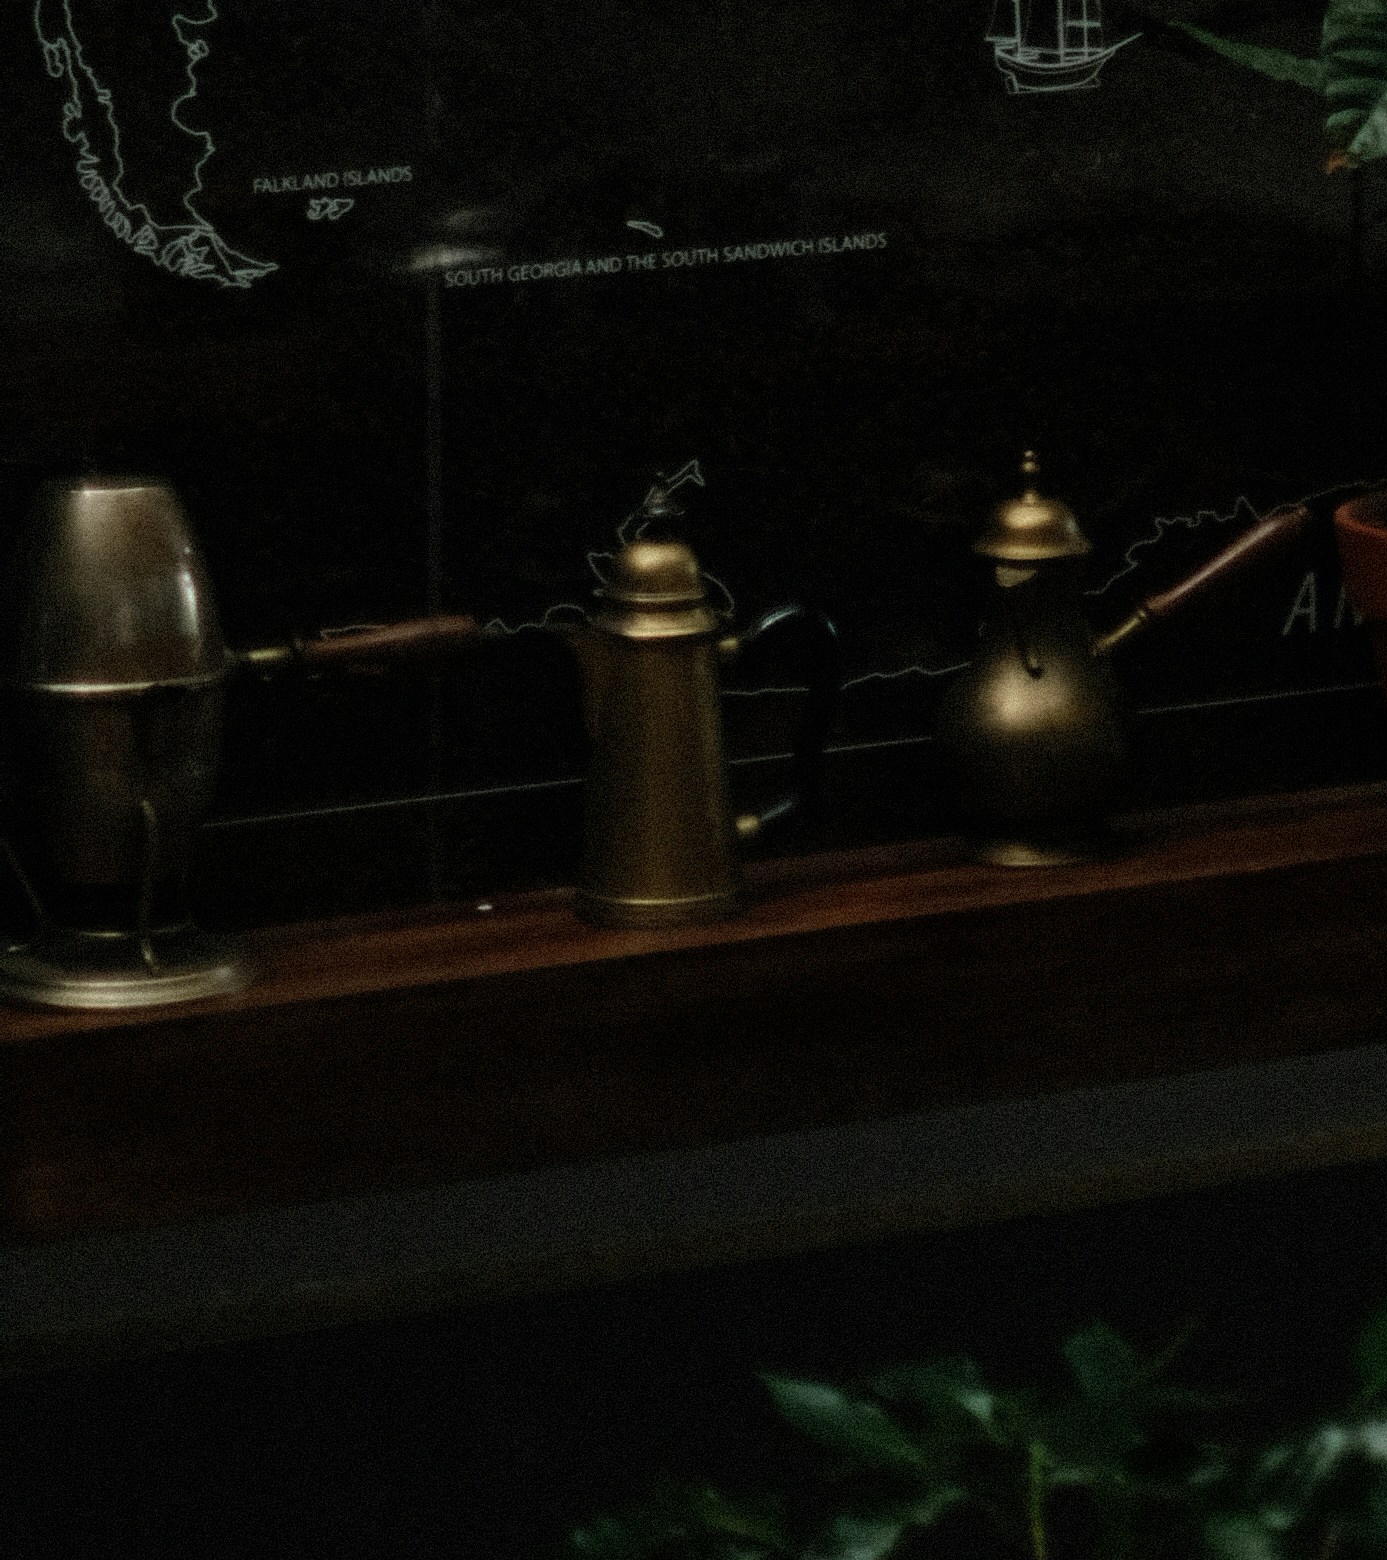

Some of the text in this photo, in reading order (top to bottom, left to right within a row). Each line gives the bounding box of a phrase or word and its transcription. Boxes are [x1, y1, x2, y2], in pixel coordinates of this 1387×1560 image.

[253, 164, 414, 194] FALKLAND ISLANDS
[443, 230, 889, 289] SOUTH GEORGIA AND THE SOUTH SANDWICH ISLANDS
